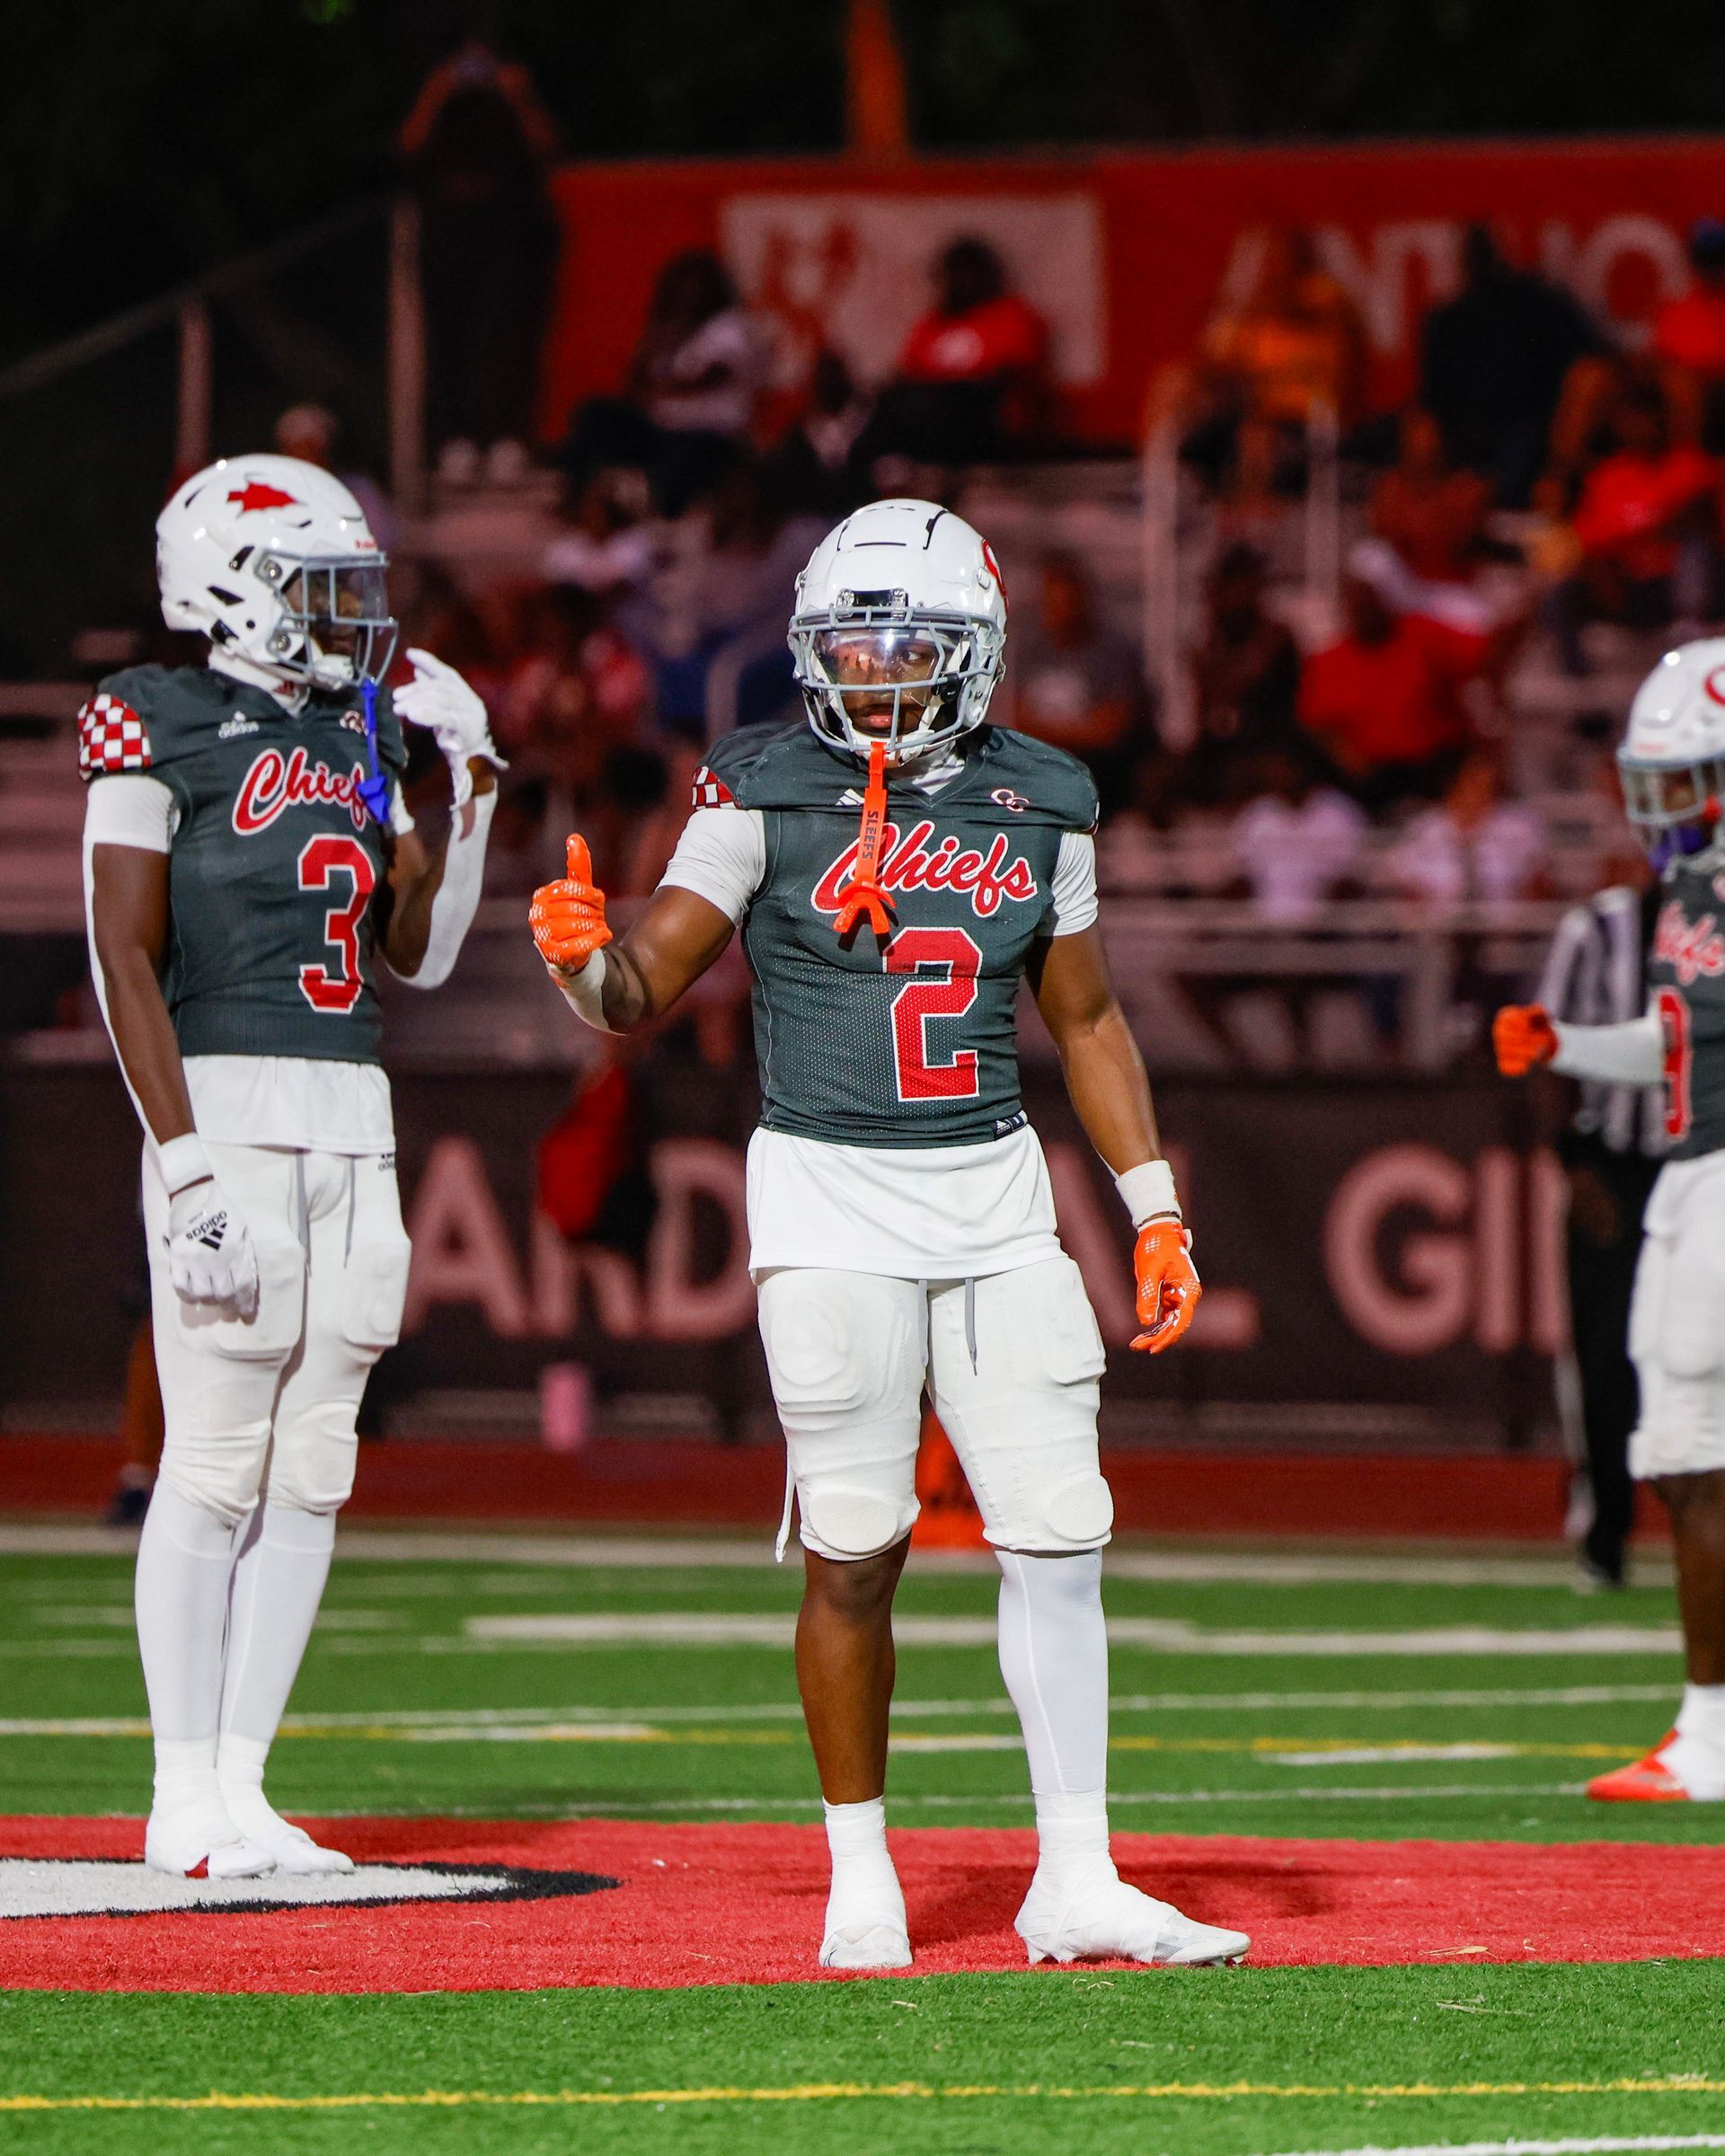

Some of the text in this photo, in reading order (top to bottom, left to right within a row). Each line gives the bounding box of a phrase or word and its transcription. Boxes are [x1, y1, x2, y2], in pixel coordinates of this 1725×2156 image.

[232, 747, 368, 832] Chief
[862, 810, 879, 860] SLEEFS
[810, 820, 1038, 918] Chiefs
[297, 833, 376, 1014] 3
[882, 926, 983, 1102] 2
[186, 1210, 227, 1240] adidas
